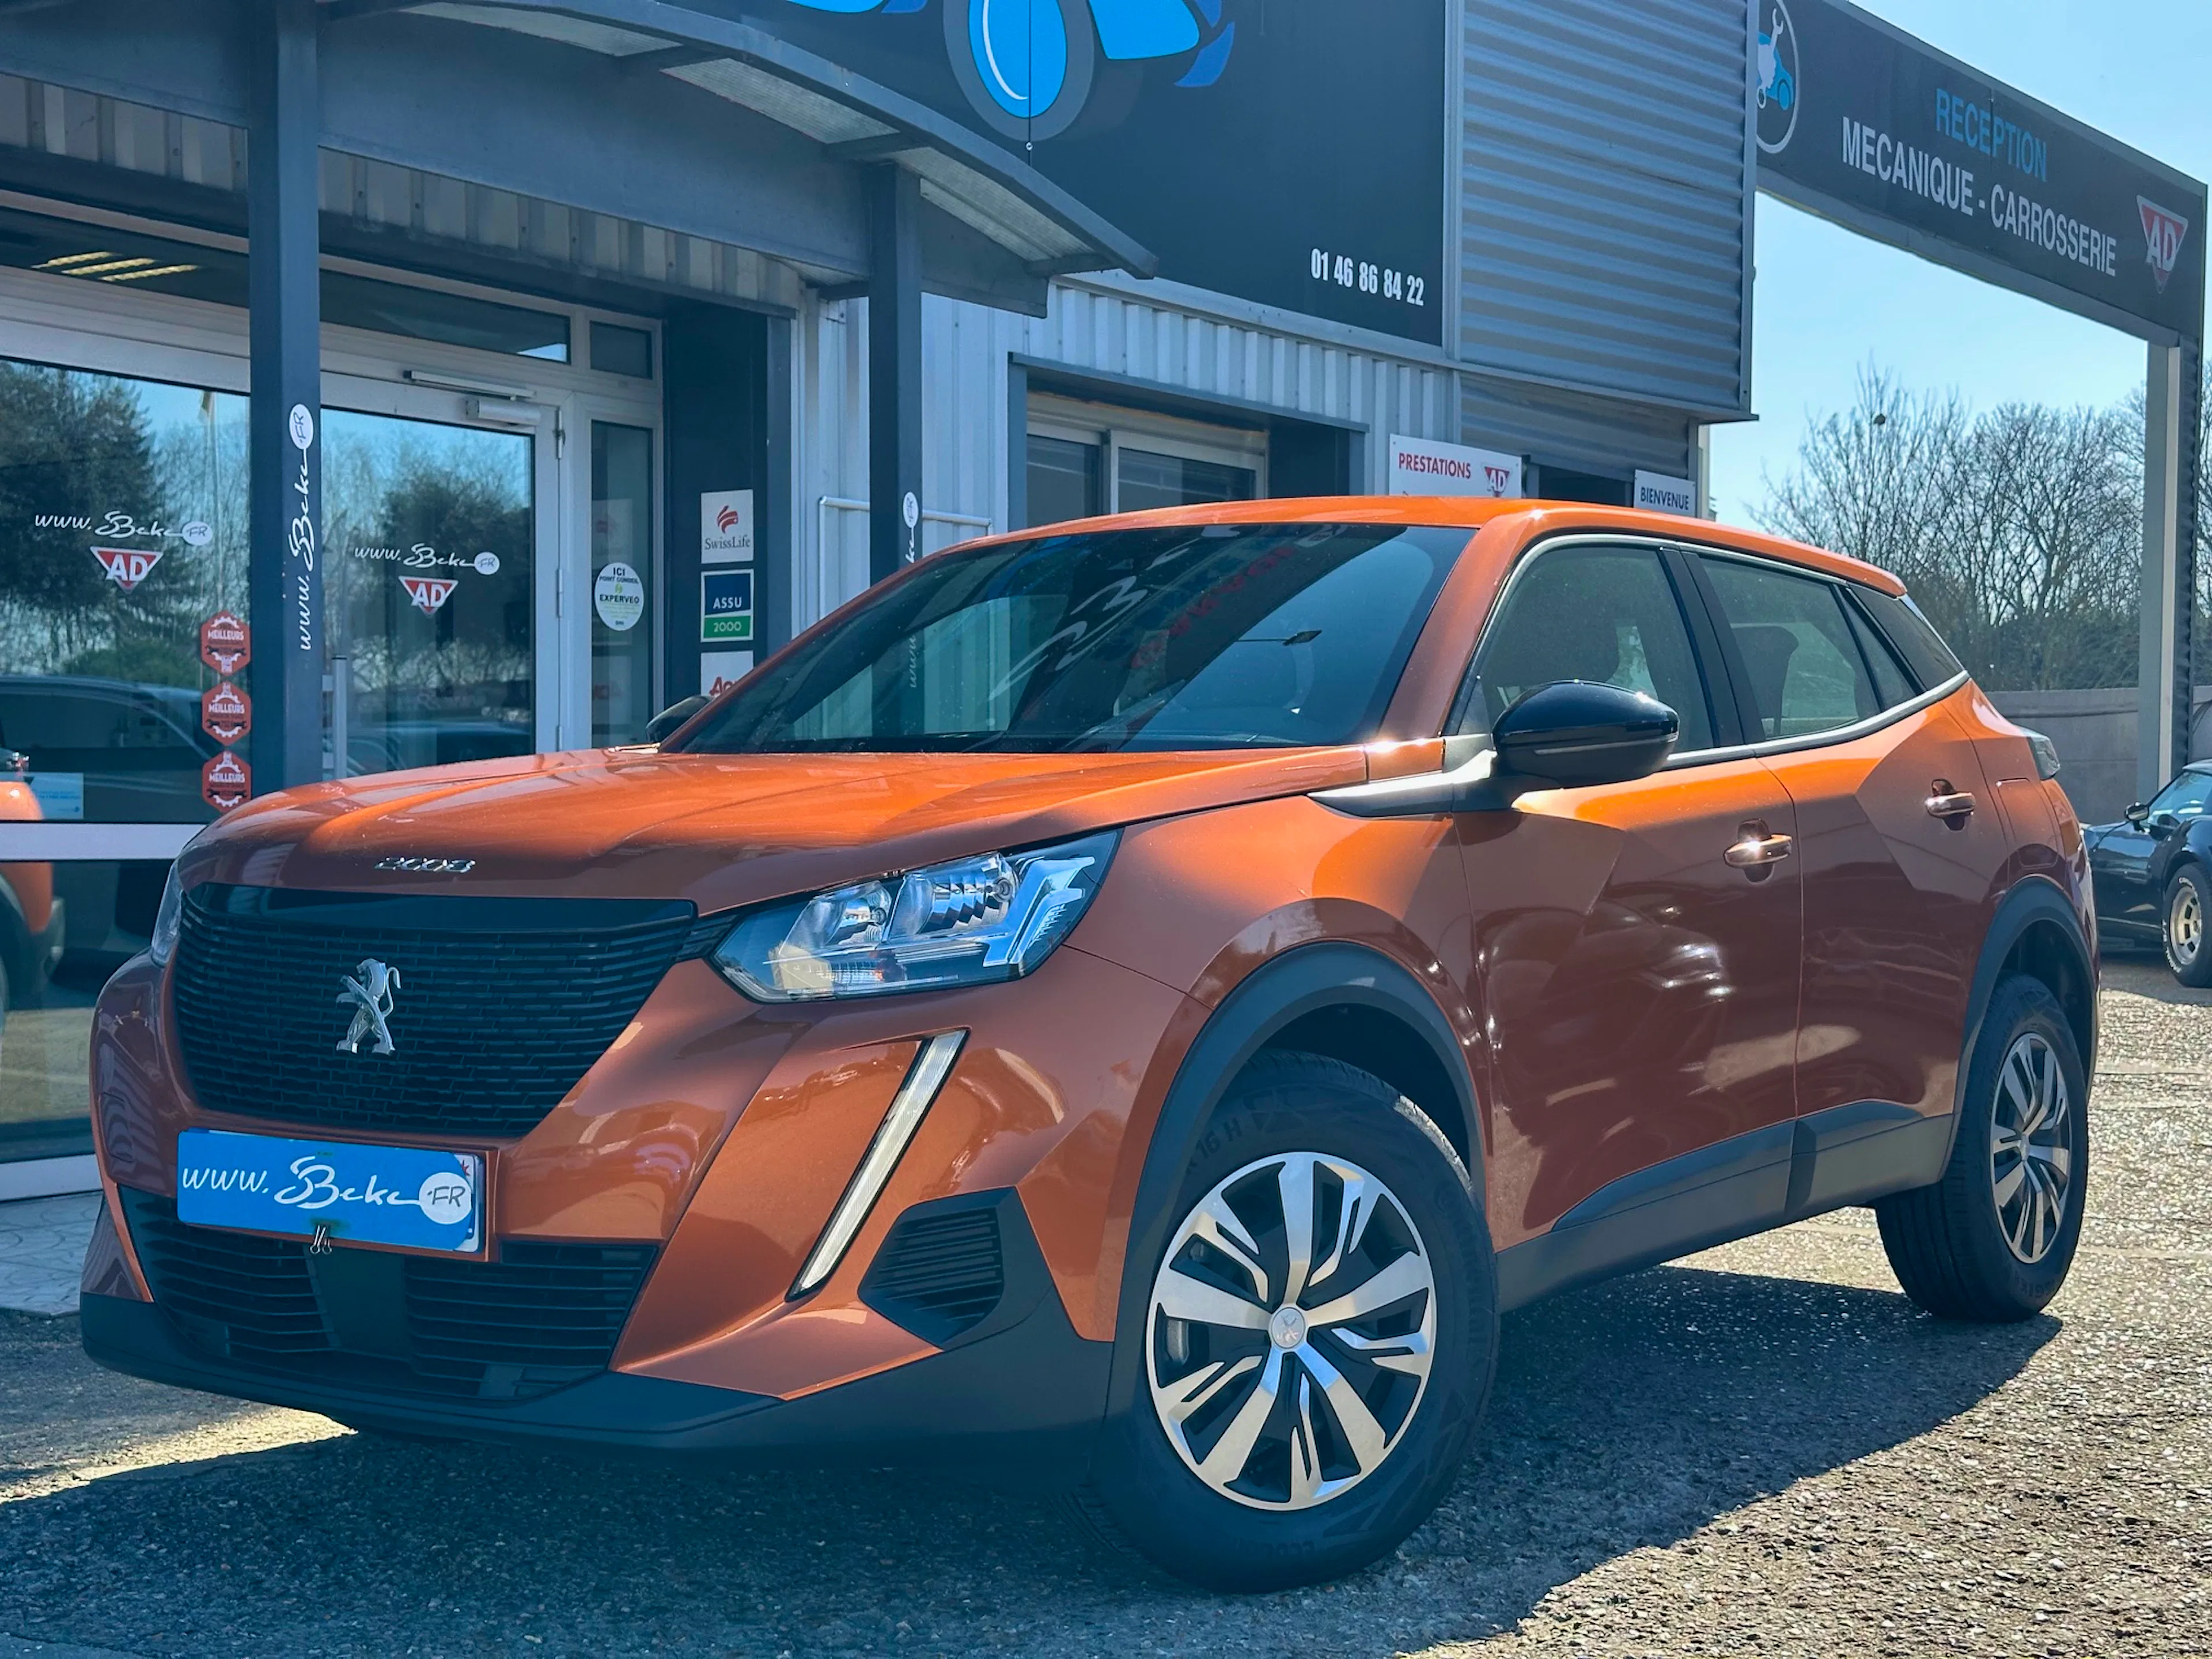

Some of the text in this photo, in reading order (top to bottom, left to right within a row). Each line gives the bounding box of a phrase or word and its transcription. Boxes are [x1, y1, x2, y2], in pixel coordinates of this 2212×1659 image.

[1936, 87, 2048, 183] RECEPTION
[1842, 116, 1974, 218] MECANIQUE
[1990, 183, 2117, 277] CARROSSERIE
[2145, 214, 2178, 273] AD
[1310, 248, 1425, 307] 01 46 86 84 22
[1398, 452, 1472, 479] PRESTATIONS
[1487, 469, 1508, 493] AD
[1639, 486, 1690, 511] BIENVENUE
[704, 535, 751, 550] SwissLife
[105, 554, 150, 582] AD
[613, 566, 626, 576] ICI
[411, 582, 448, 609] AD
[600, 593, 640, 604] EXPERVEO
[713, 597, 743, 609] ASSU
[208, 629, 244, 641] MEILLEURS
[713, 621, 742, 632] 2000
[209, 704, 245, 714] MEILLEURS
[209, 772, 246, 783] MEILLEURS
[373, 856, 477, 873] 2008
[1195, 1130, 1221, 1160] 16
